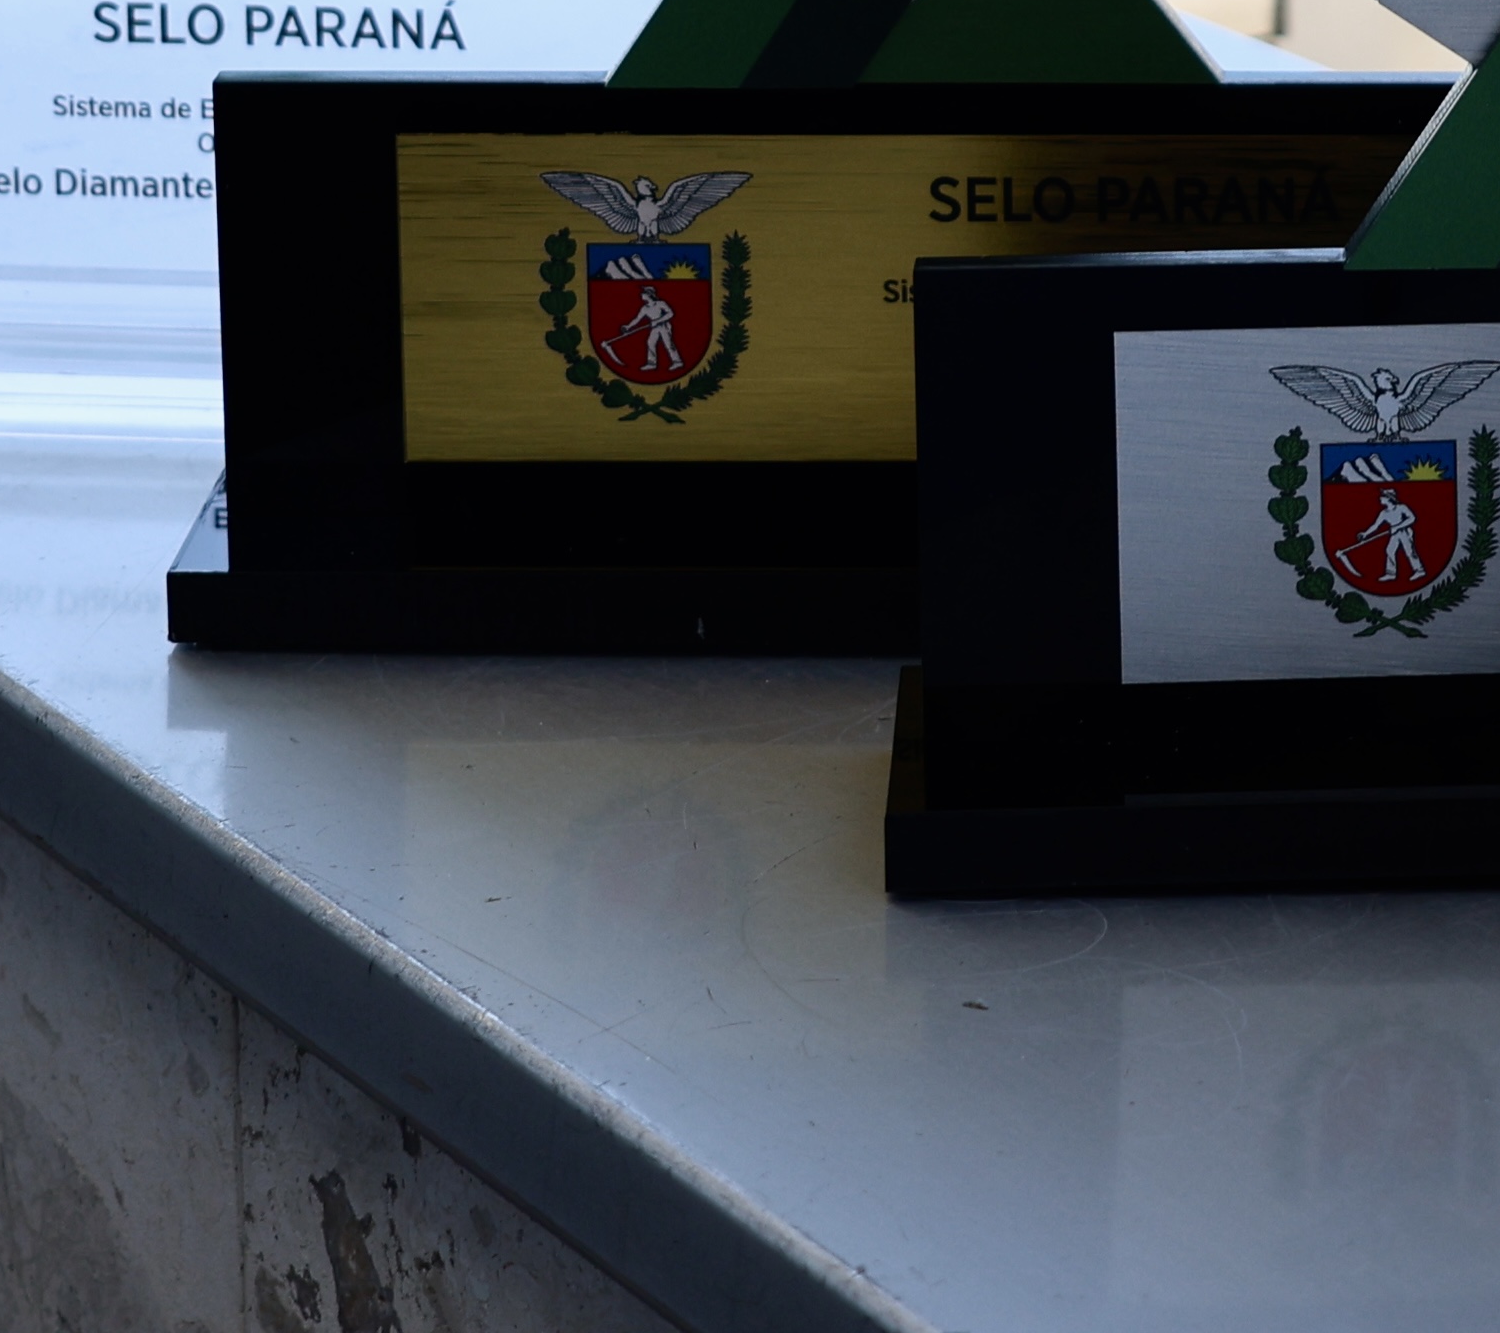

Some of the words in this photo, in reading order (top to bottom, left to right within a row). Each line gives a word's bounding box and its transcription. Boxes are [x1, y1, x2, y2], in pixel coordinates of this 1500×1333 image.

[92, 2, 225, 46] SELO
[244, 0, 467, 51] PARANÁ
[52, 95, 152, 119] Sistema
[160, 96, 192, 120] de
[54, 168, 214, 200] Diamante
[928, 176, 1075, 223] SELO
[1097, 165, 1342, 224] PARANÁ
